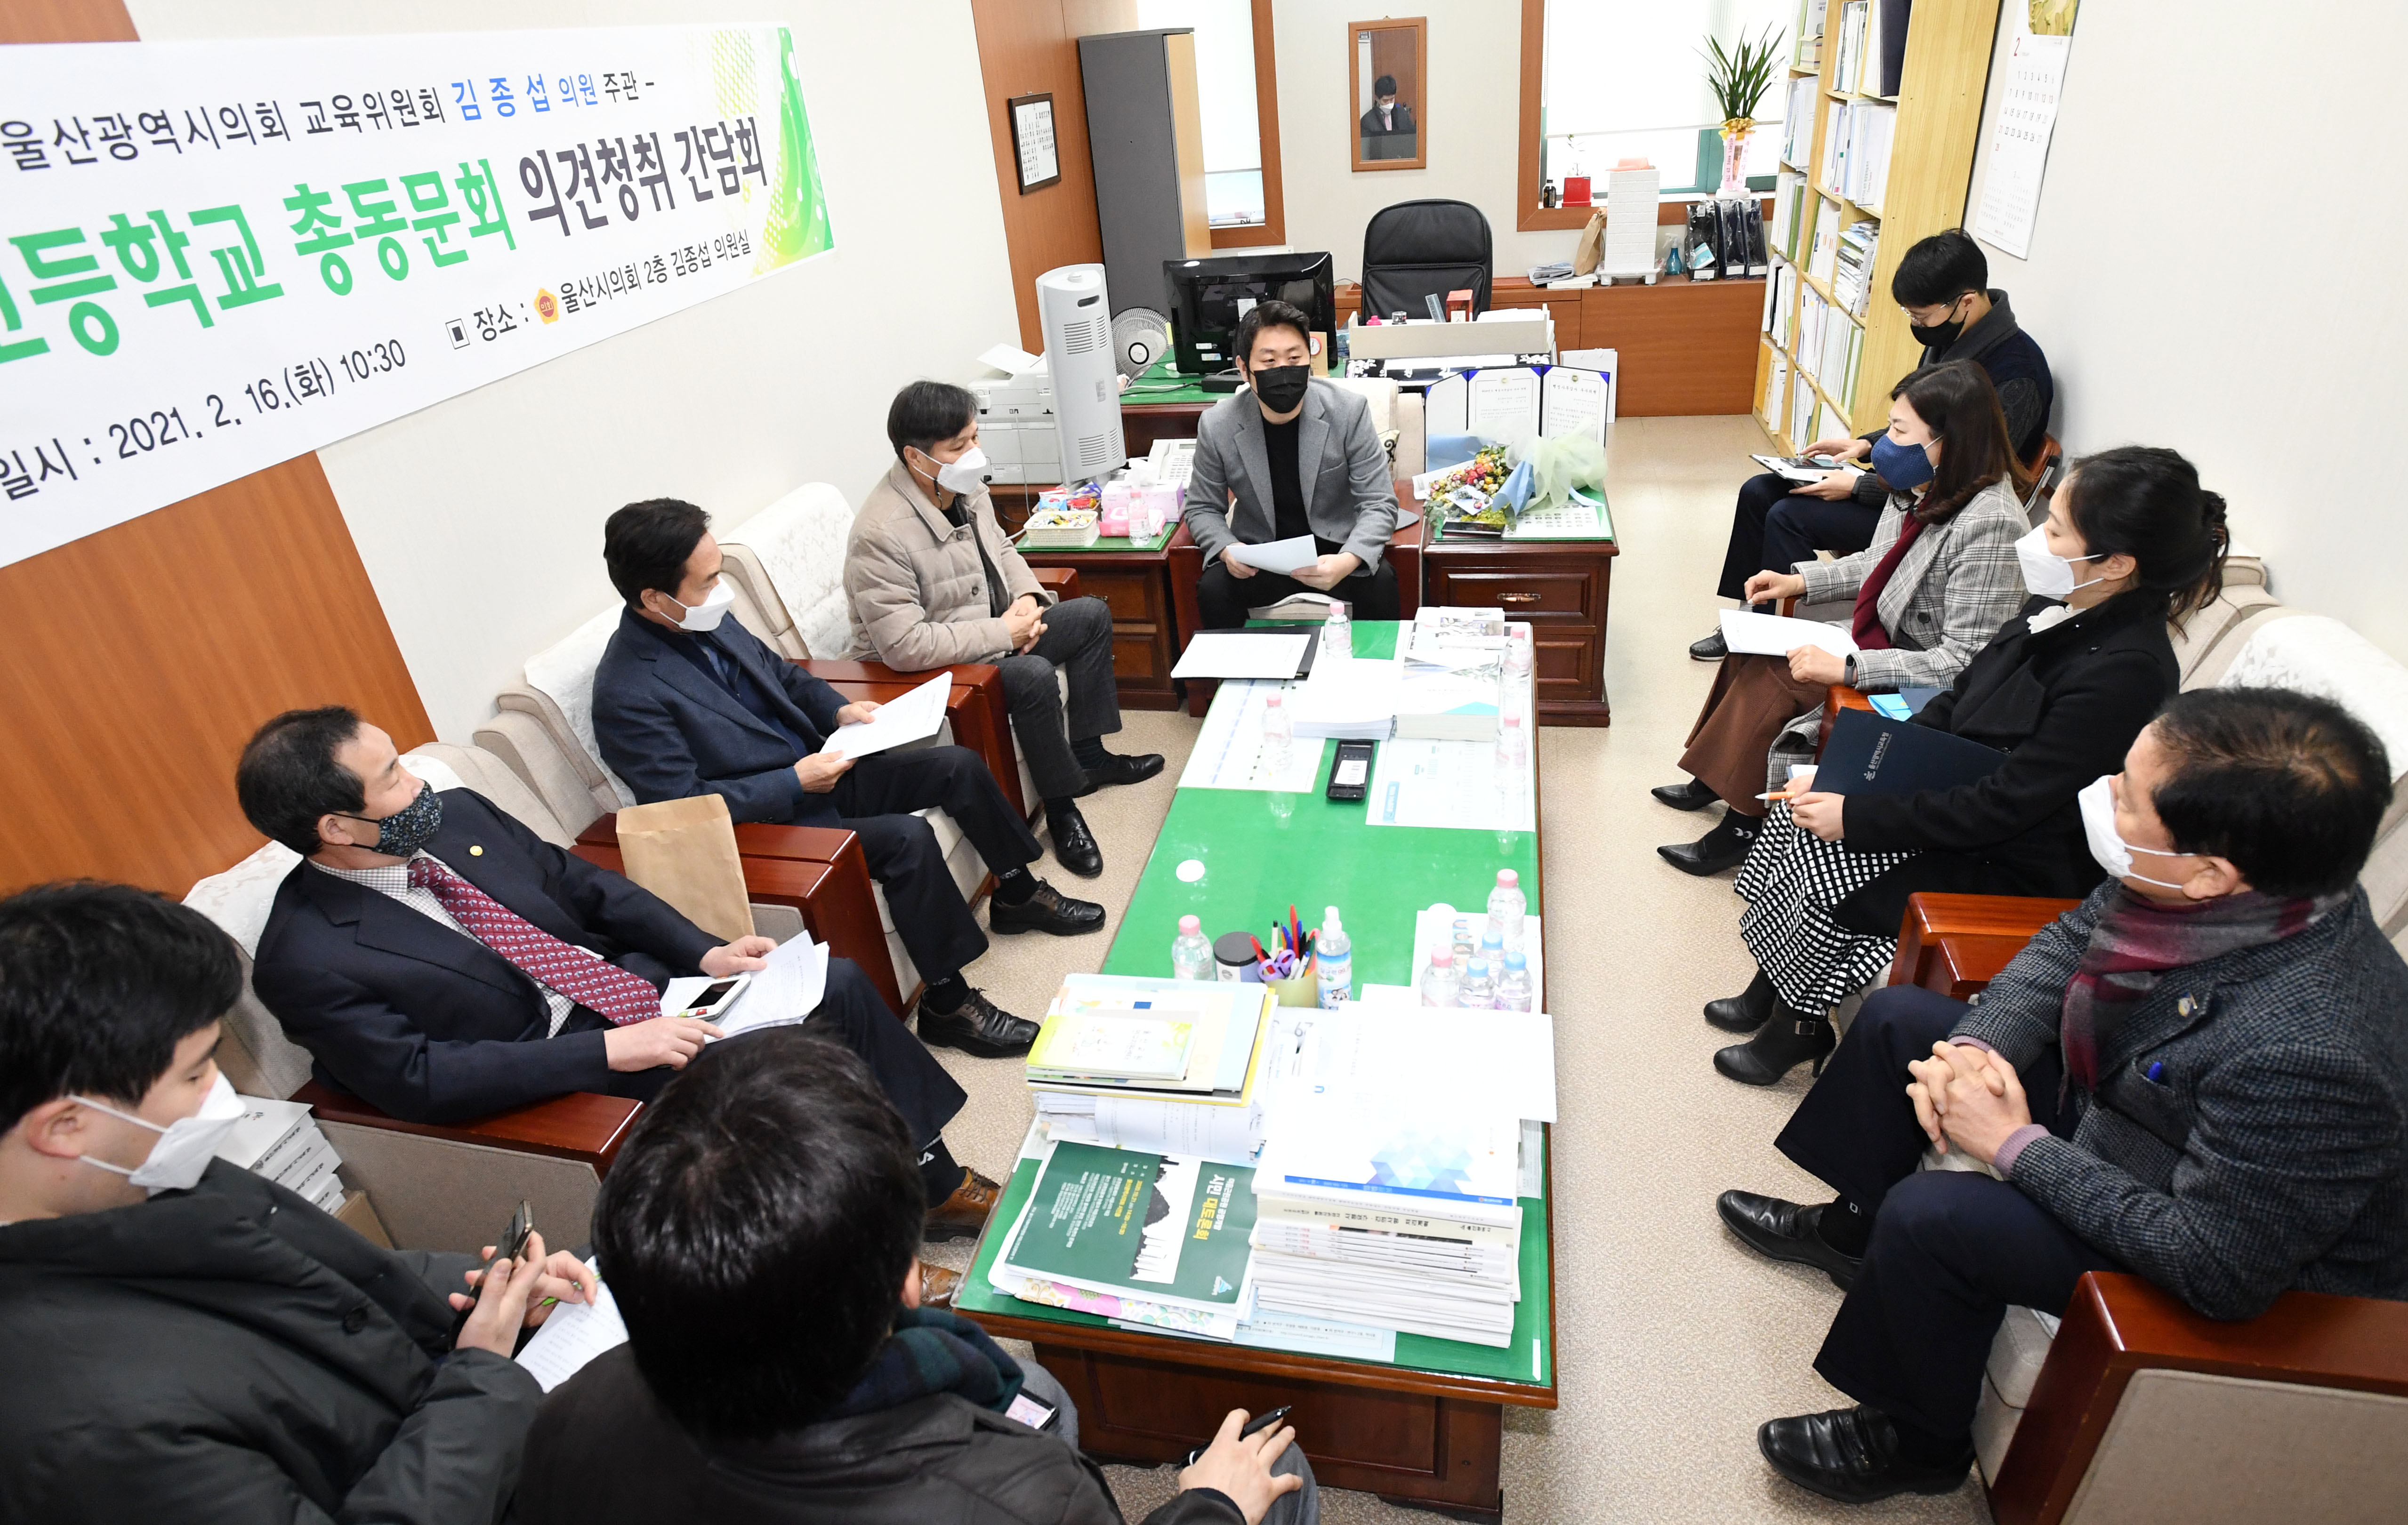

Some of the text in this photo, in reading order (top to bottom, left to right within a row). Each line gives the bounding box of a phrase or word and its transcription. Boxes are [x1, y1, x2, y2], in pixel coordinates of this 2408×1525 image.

[2013, 37, 2020, 56] 2
[2018, 71, 2020, 79] 1
[2024, 72, 2027, 80] 2
[2031, 72, 2033, 80] 3
[2038, 73, 2040, 81] 4
[2045, 74, 2047, 83] 5
[2009, 88, 2053, 104] 7 8 9 10 11 12 13
[0, 100, 291, 171] 울산광역시의회
[300, 88, 445, 135] 교육위원회
[558, 73, 598, 108] 의원
[603, 71, 639, 103] 주관
[2010, 108, 2015, 116] 15
[2016, 109, 2021, 118] 16
[2022, 111, 2028, 119] 17
[2029, 112, 2034, 120] 18
[2036, 113, 2041, 122] 19
[1995, 143, 2000, 151] 28
[1998, 125, 2003, 133] 21
[2005, 127, 2009, 135] 22
[2011, 128, 2015, 136] 23
[2017, 129, 2021, 138] 24
[2023, 131, 2029, 140] 25
[2030, 133, 2035, 142] 26
[282, 158, 516, 296] 총동문회
[519, 131, 676, 237] 의견청취
[674, 116, 767, 202] 간담회
[473, 303, 517, 342] 장소
[560, 265, 642, 314] 울산시의회
[644, 255, 668, 283] 2층
[671, 244, 712, 277] 김종섭
[714, 229, 751, 262] 의원실
[0, 438, 78, 501] 일시
[109, 407, 203, 459] 2021.
[206, 394, 242, 427] 2.
[245, 356, 335, 414] 16.(화)
[339, 339, 406, 383] 10:30
[1868, 732, 1889, 769] 울산광역시교육청
[1193, 1174, 1225, 1240] 시민 대토론회
